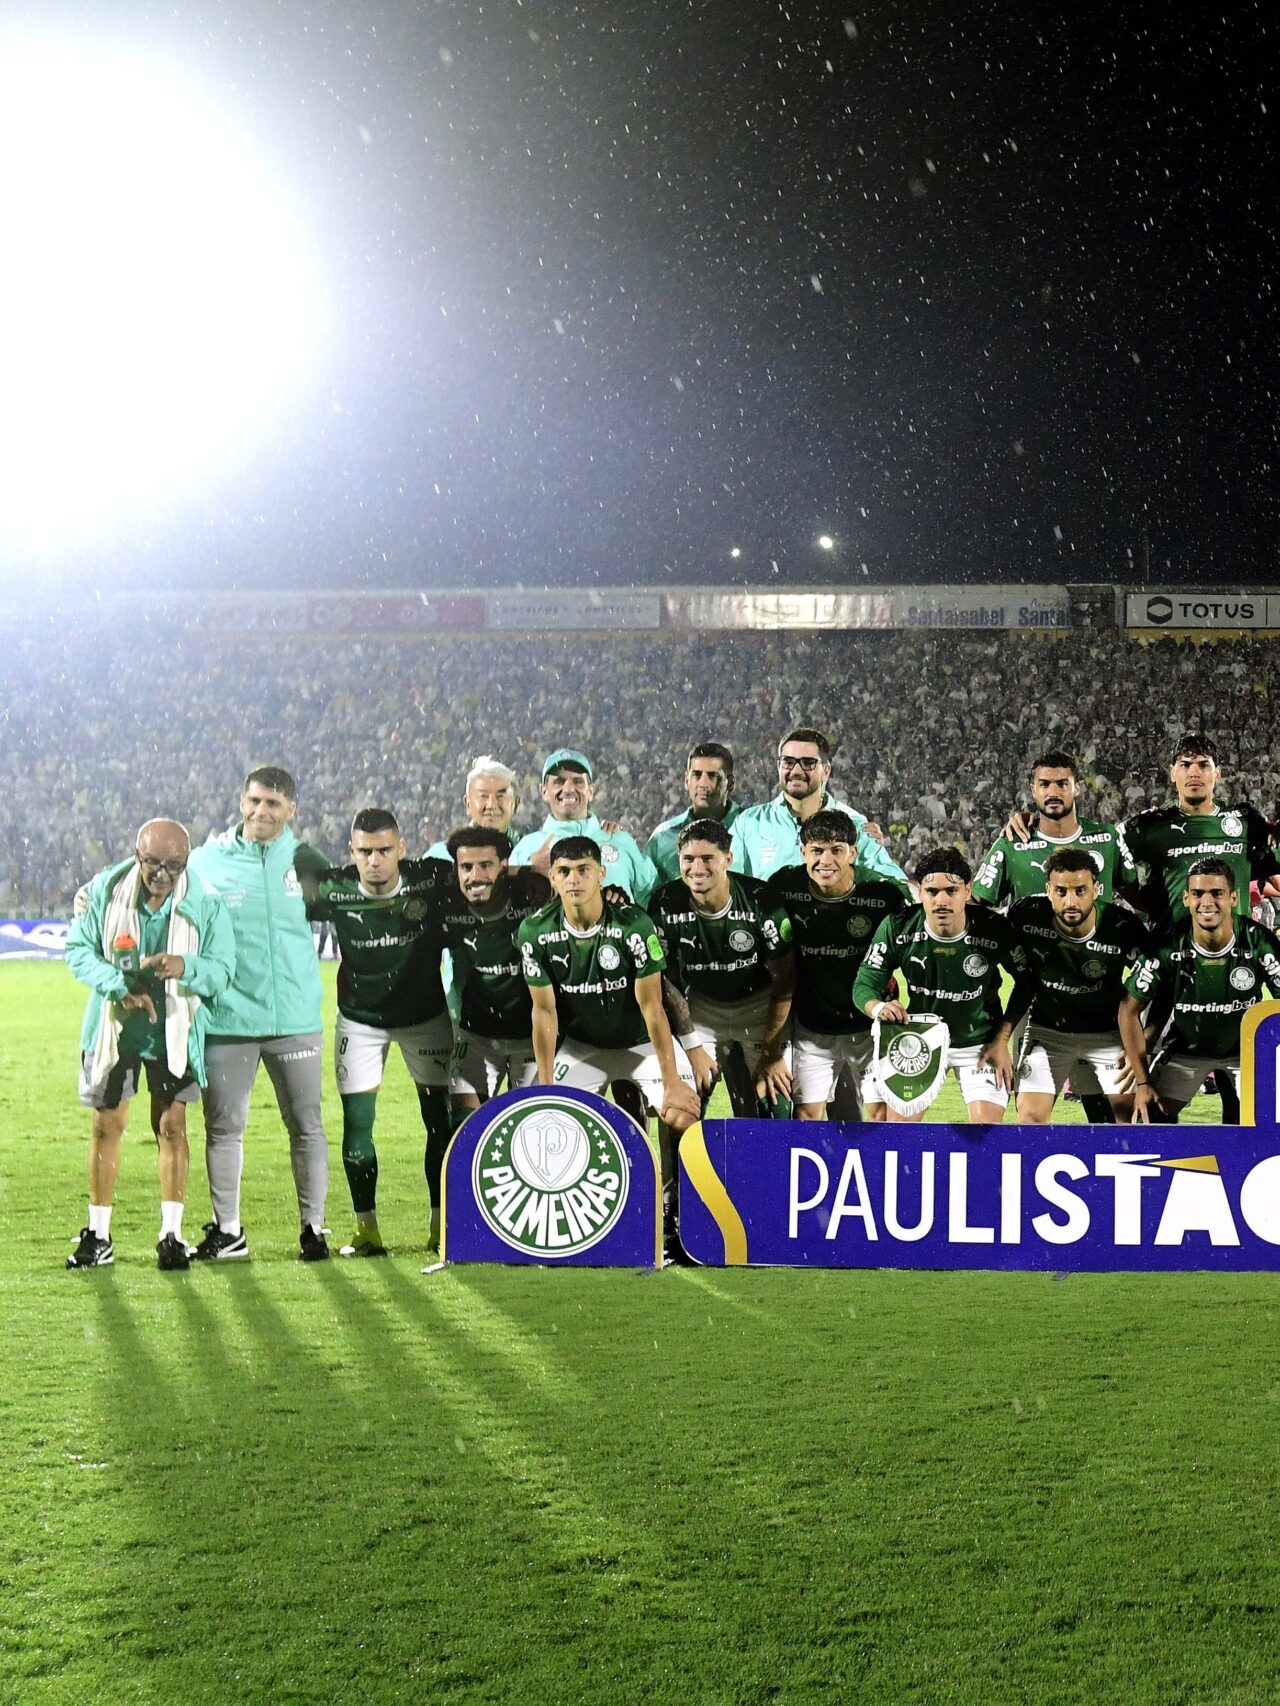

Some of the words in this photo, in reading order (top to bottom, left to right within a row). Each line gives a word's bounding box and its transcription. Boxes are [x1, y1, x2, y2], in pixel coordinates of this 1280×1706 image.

[1178, 603, 1254, 618] TOTVS
[1079, 832, 1112, 844] CIMED
[1013, 841, 1048, 852] CIMED
[1167, 842, 1243, 857] sportingbet
[848, 897, 886, 908] CIMED
[538, 930, 569, 945] CIMED
[896, 932, 929, 945] CIMED
[1022, 925, 1058, 939] CIMED
[964, 936, 998, 950] CIMED
[1086, 940, 1121, 954] CIMED
[1175, 996, 1257, 1014] sportingbet
[889, 1050, 930, 1075] PALMEIRAS
[482, 1165, 620, 1248] PALMEIRAS
